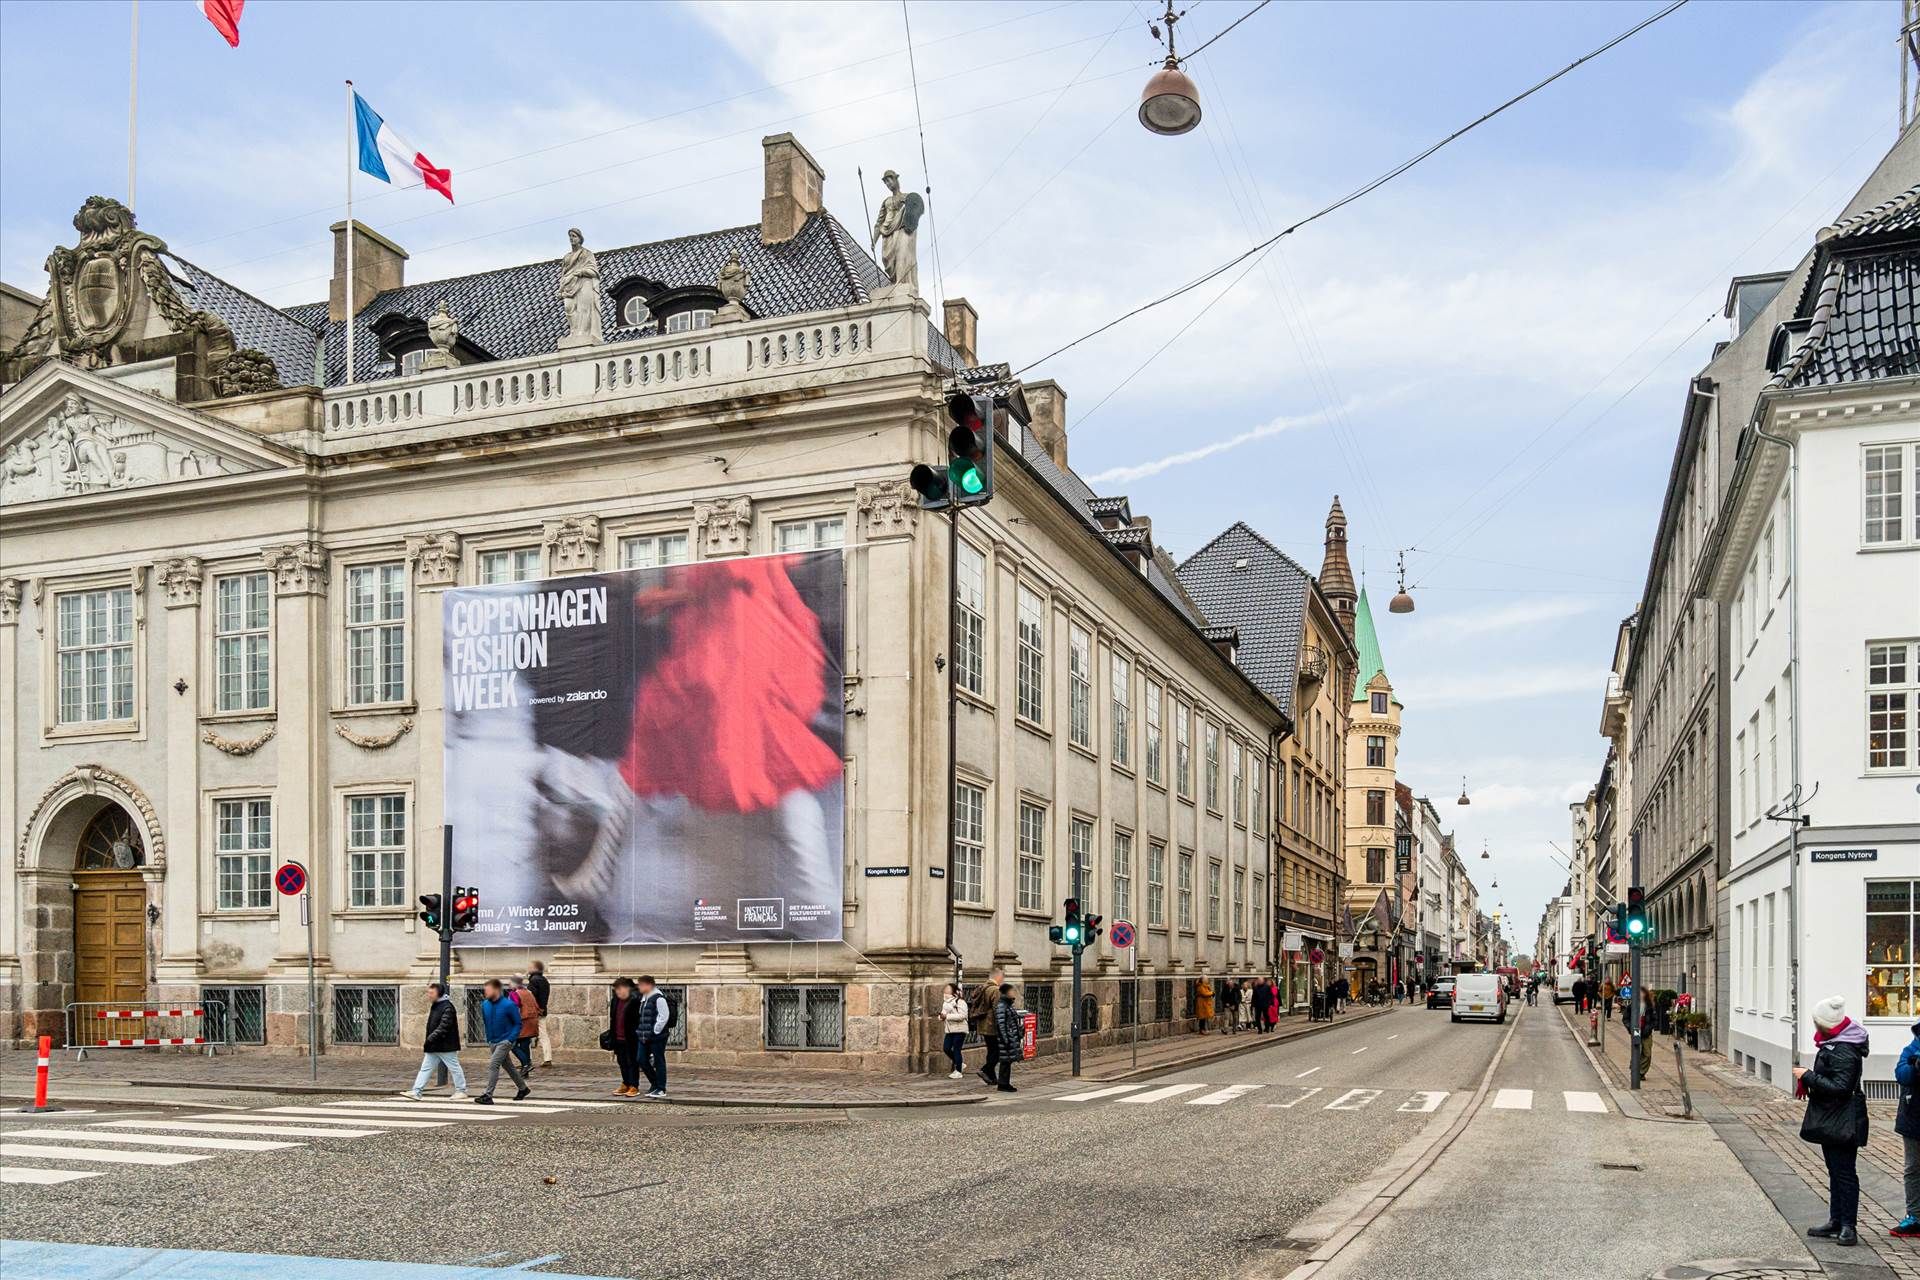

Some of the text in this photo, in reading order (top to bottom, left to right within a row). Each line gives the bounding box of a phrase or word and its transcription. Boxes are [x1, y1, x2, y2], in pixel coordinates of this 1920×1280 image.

[452, 587, 607, 637] COPENHAGEN
[452, 631, 548, 675] FASHION
[452, 671, 518, 712] WEEK
[529, 689, 607, 705] powered by zalando
[1815, 851, 1872, 860] Kongens Nytorv
[508, 905, 545, 917] Winter
[548, 904, 578, 917] 2025
[744, 905, 774, 914] INSTITUT
[474, 922, 511, 934] anuary
[524, 920, 539, 932] 31
[543, 919, 587, 932] January
